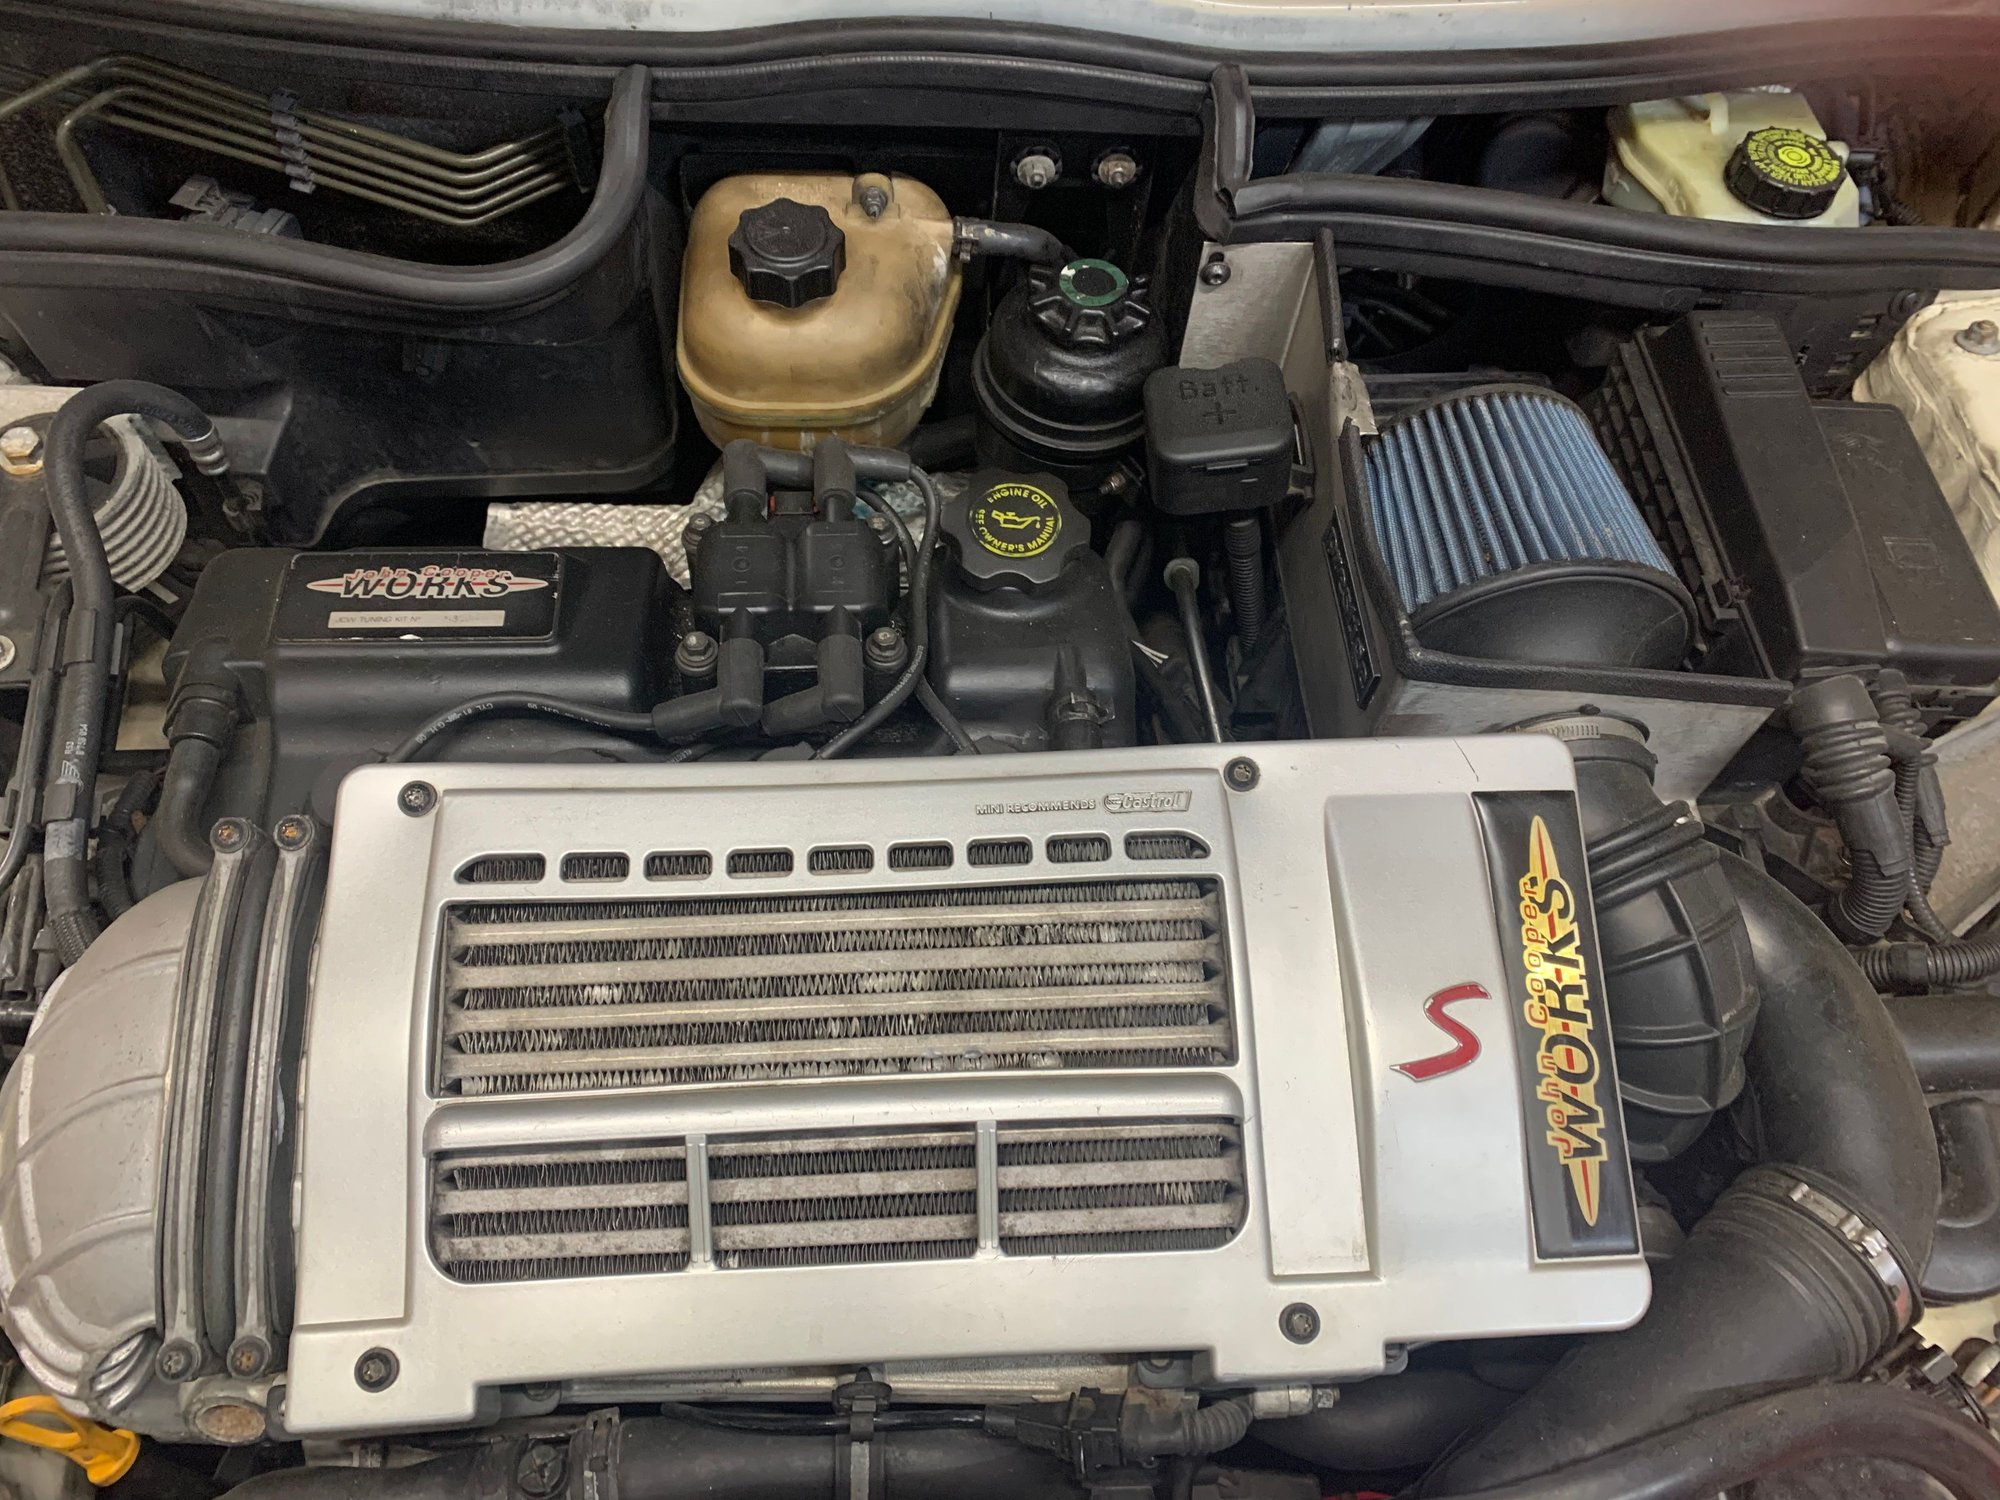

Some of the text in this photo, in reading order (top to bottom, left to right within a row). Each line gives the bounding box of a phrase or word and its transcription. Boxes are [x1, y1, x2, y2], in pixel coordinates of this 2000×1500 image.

[987, 488, 1049, 509] ENGINE OIL
[975, 508, 1055, 552] SEE OWNER'S MANUAL
[343, 572, 512, 597] WORKS
[348, 565, 511, 581] John Cooper
[360, 616, 393, 624] TUNING
[975, 792, 1180, 815] MINI RECOMMENDS Castrol
[1523, 880, 1572, 1157] John Cooper
[1530, 877, 1605, 1159] WORKS
[1389, 981, 1492, 1082] S
